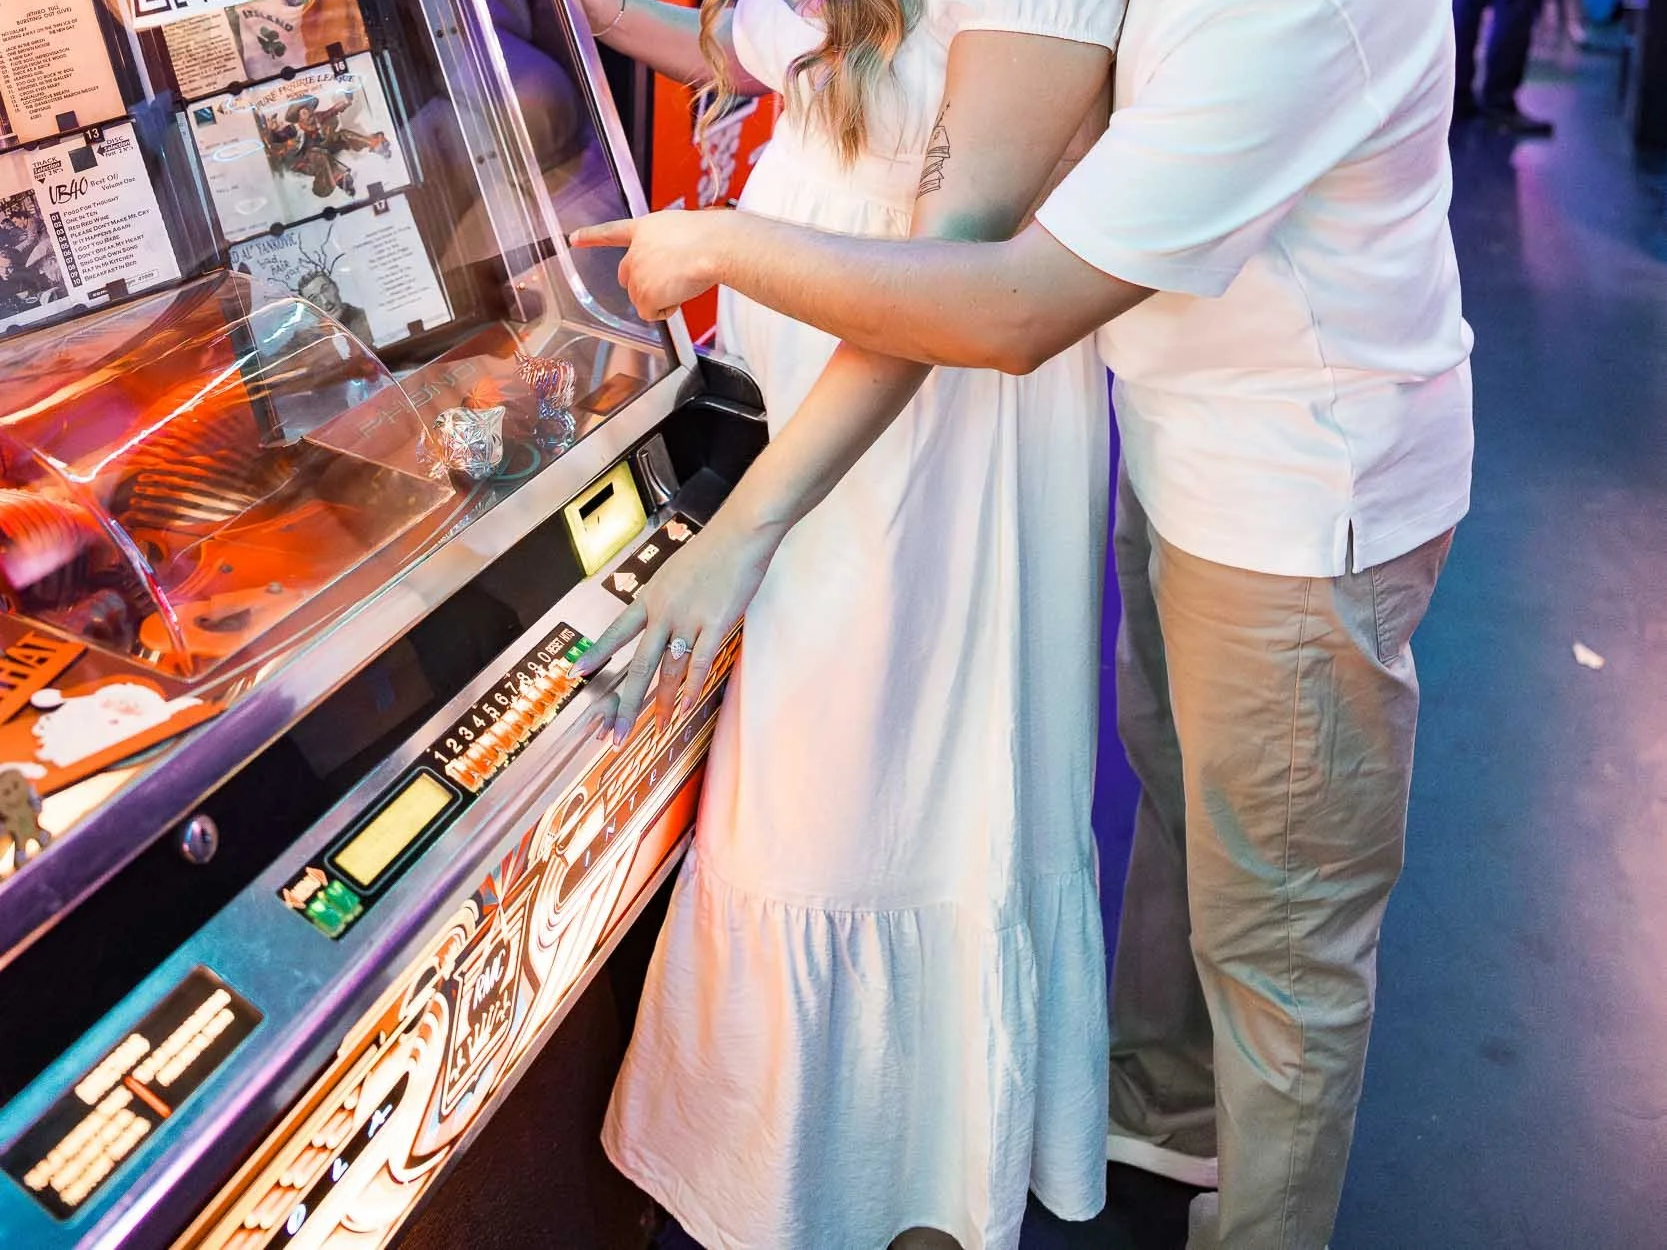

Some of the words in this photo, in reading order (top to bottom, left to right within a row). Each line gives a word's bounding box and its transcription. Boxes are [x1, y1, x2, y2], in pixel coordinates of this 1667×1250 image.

[85, 128, 100, 140] 13
[106, 136, 123, 145] DISC
[32, 157, 57, 168] TRACK
[48, 177, 89, 205] UB40
[101, 181, 124, 192] Volume
[63, 208, 79, 216] FOOD
[92, 195, 119, 207] THOUGHT
[65, 216, 78, 224] ONE
[68, 223, 81, 231] RED
[80, 219, 94, 227] RED
[93, 214, 109, 223] WINE
[70, 227, 93, 238] PLEASE
[92, 221, 110, 231] DON'T
[110, 216, 127, 225] MAKE
[137, 208, 150, 216] CRY
[84, 229, 113, 241] HAPPENS
[112, 223, 131, 232] AGAIN
[77, 244, 90, 252] GOT
[90, 239, 104, 247] YOU
[104, 234, 120, 243] BABE
[95, 243, 116, 253] BREAK
[125, 234, 144, 243] HEART
[80, 258, 94, 266] SING
[93, 254, 107, 262] OUR
[107, 249, 122, 257] OWN
[121, 243, 138, 252] SONG
[82, 266, 96, 274] RAT
[108, 253, 134, 265] KITCHEN
[84, 266, 119, 281] BREAKFAST
[434, 750, 449, 763] 1
[446, 738, 463, 753] 2
[458, 726, 474, 741] 3
[472, 714, 486, 729] 4
[482, 702, 501, 720] 5
[494, 692, 509, 705] 6
[504, 681, 518, 694] 7
[517, 671, 531, 686] 8
[527, 661, 544, 674] 9
[537, 651, 551, 663] 0
[560, 628, 576, 643] HITS
